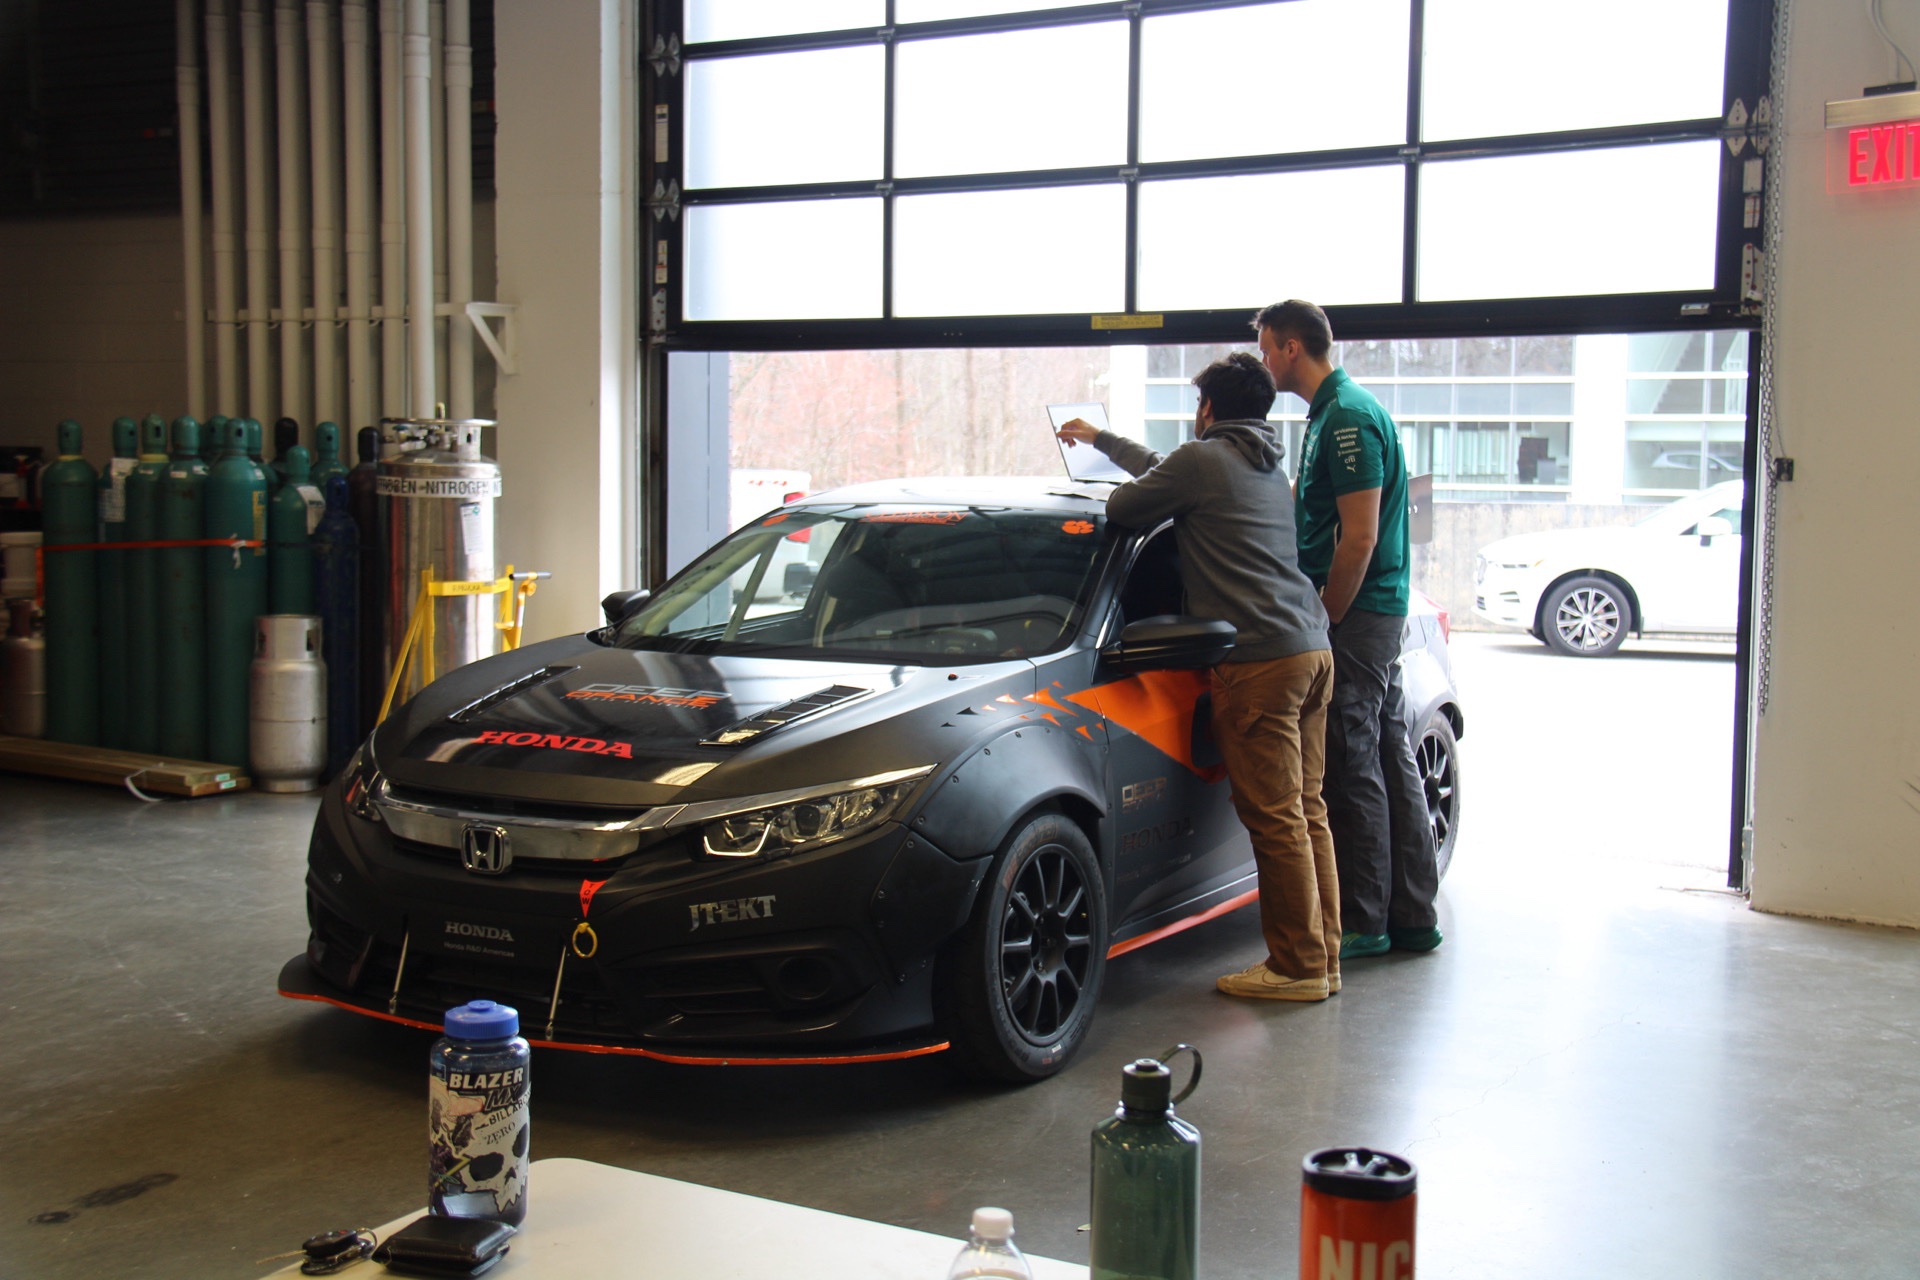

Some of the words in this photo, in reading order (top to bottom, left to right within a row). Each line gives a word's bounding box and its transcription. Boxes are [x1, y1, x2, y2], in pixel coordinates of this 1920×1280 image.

[1848, 121, 1920, 186] EXIT
[565, 690, 721, 708] ORANGE
[577, 683, 732, 699] DEEP
[472, 730, 634, 759] HONDA
[581, 883, 596, 905] TOW
[688, 895, 776, 932] JTEKT
[445, 920, 515, 942] HONDA
[449, 1067, 524, 1089] BLAZER
[484, 1083, 522, 1112] MX
[489, 1091, 531, 1126] BILLABO
[484, 1122, 516, 1145] ZERO
[1319, 1234, 1410, 1280] NIC
